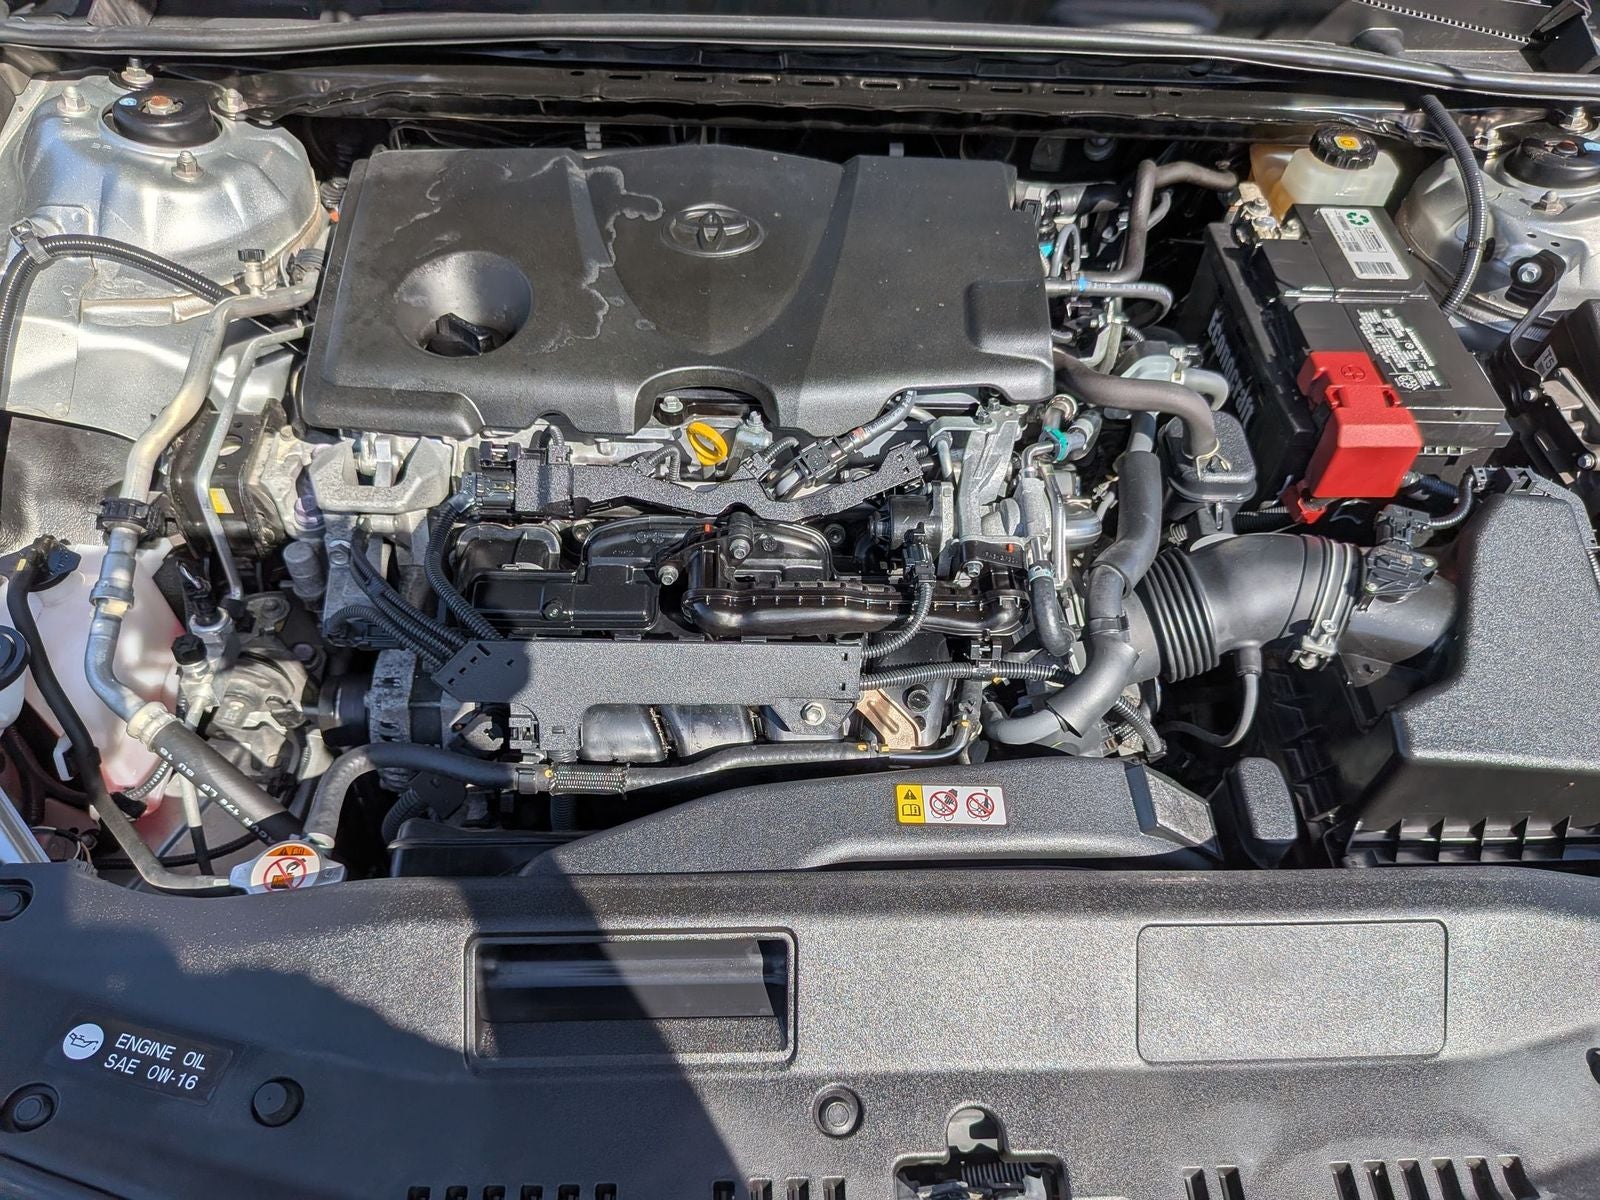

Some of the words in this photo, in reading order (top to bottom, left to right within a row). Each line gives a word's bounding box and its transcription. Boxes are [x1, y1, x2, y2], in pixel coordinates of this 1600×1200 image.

[115, 1033, 176, 1061] ENGINE
[183, 1051, 206, 1071] OIL
[104, 1053, 141, 1075] SAE
[147, 1065, 199, 1090] 0W-16
